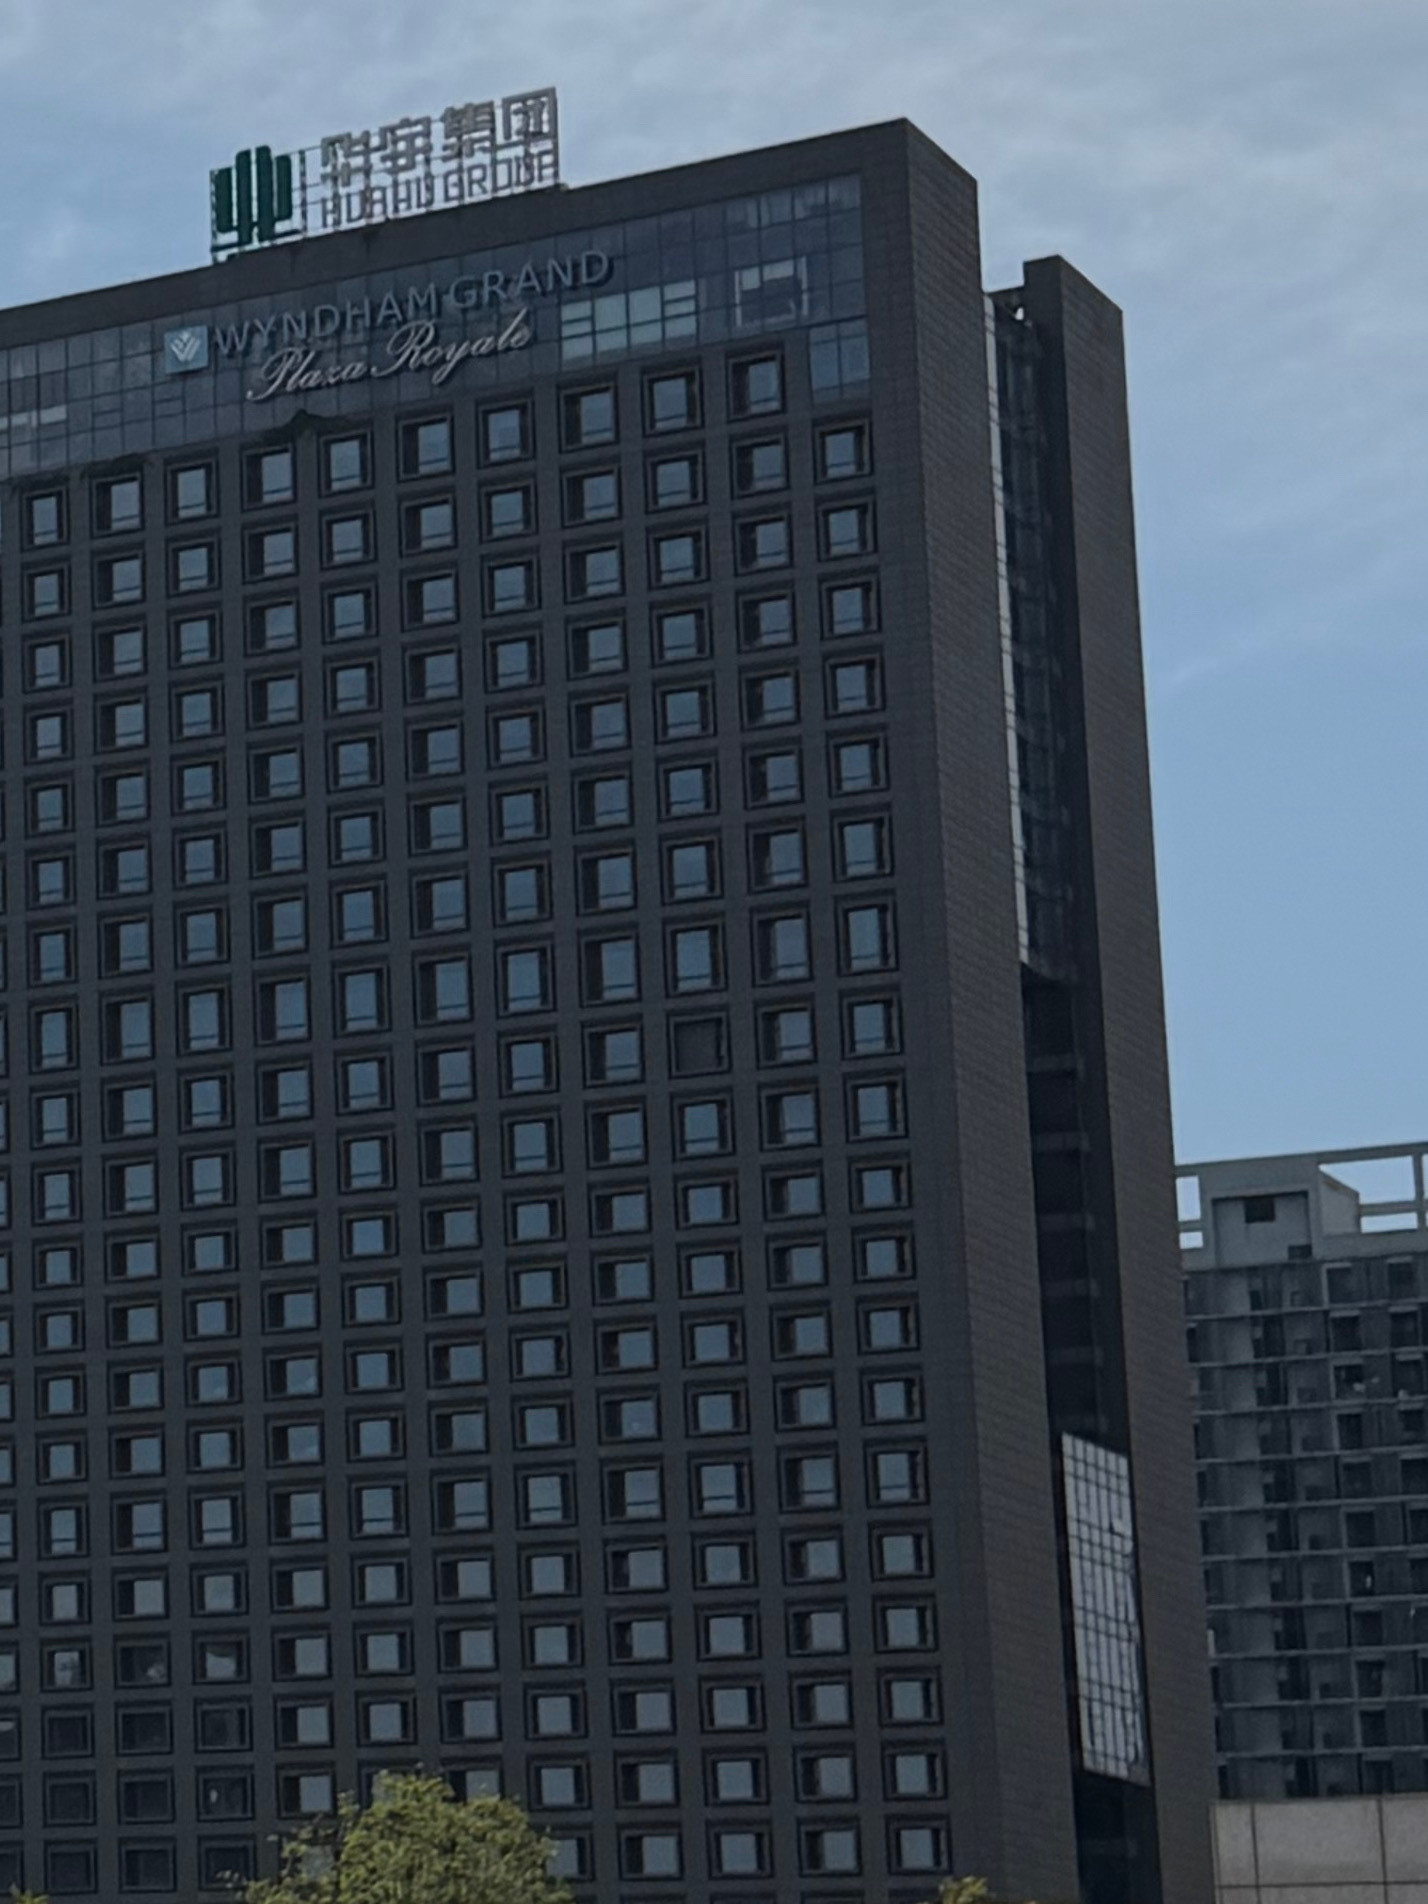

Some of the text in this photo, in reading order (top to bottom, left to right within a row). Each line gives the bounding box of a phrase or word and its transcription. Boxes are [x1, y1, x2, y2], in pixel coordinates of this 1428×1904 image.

[213, 249, 612, 356] WYNDHAM GRAND
[246, 306, 533, 402] Plaza Royale
